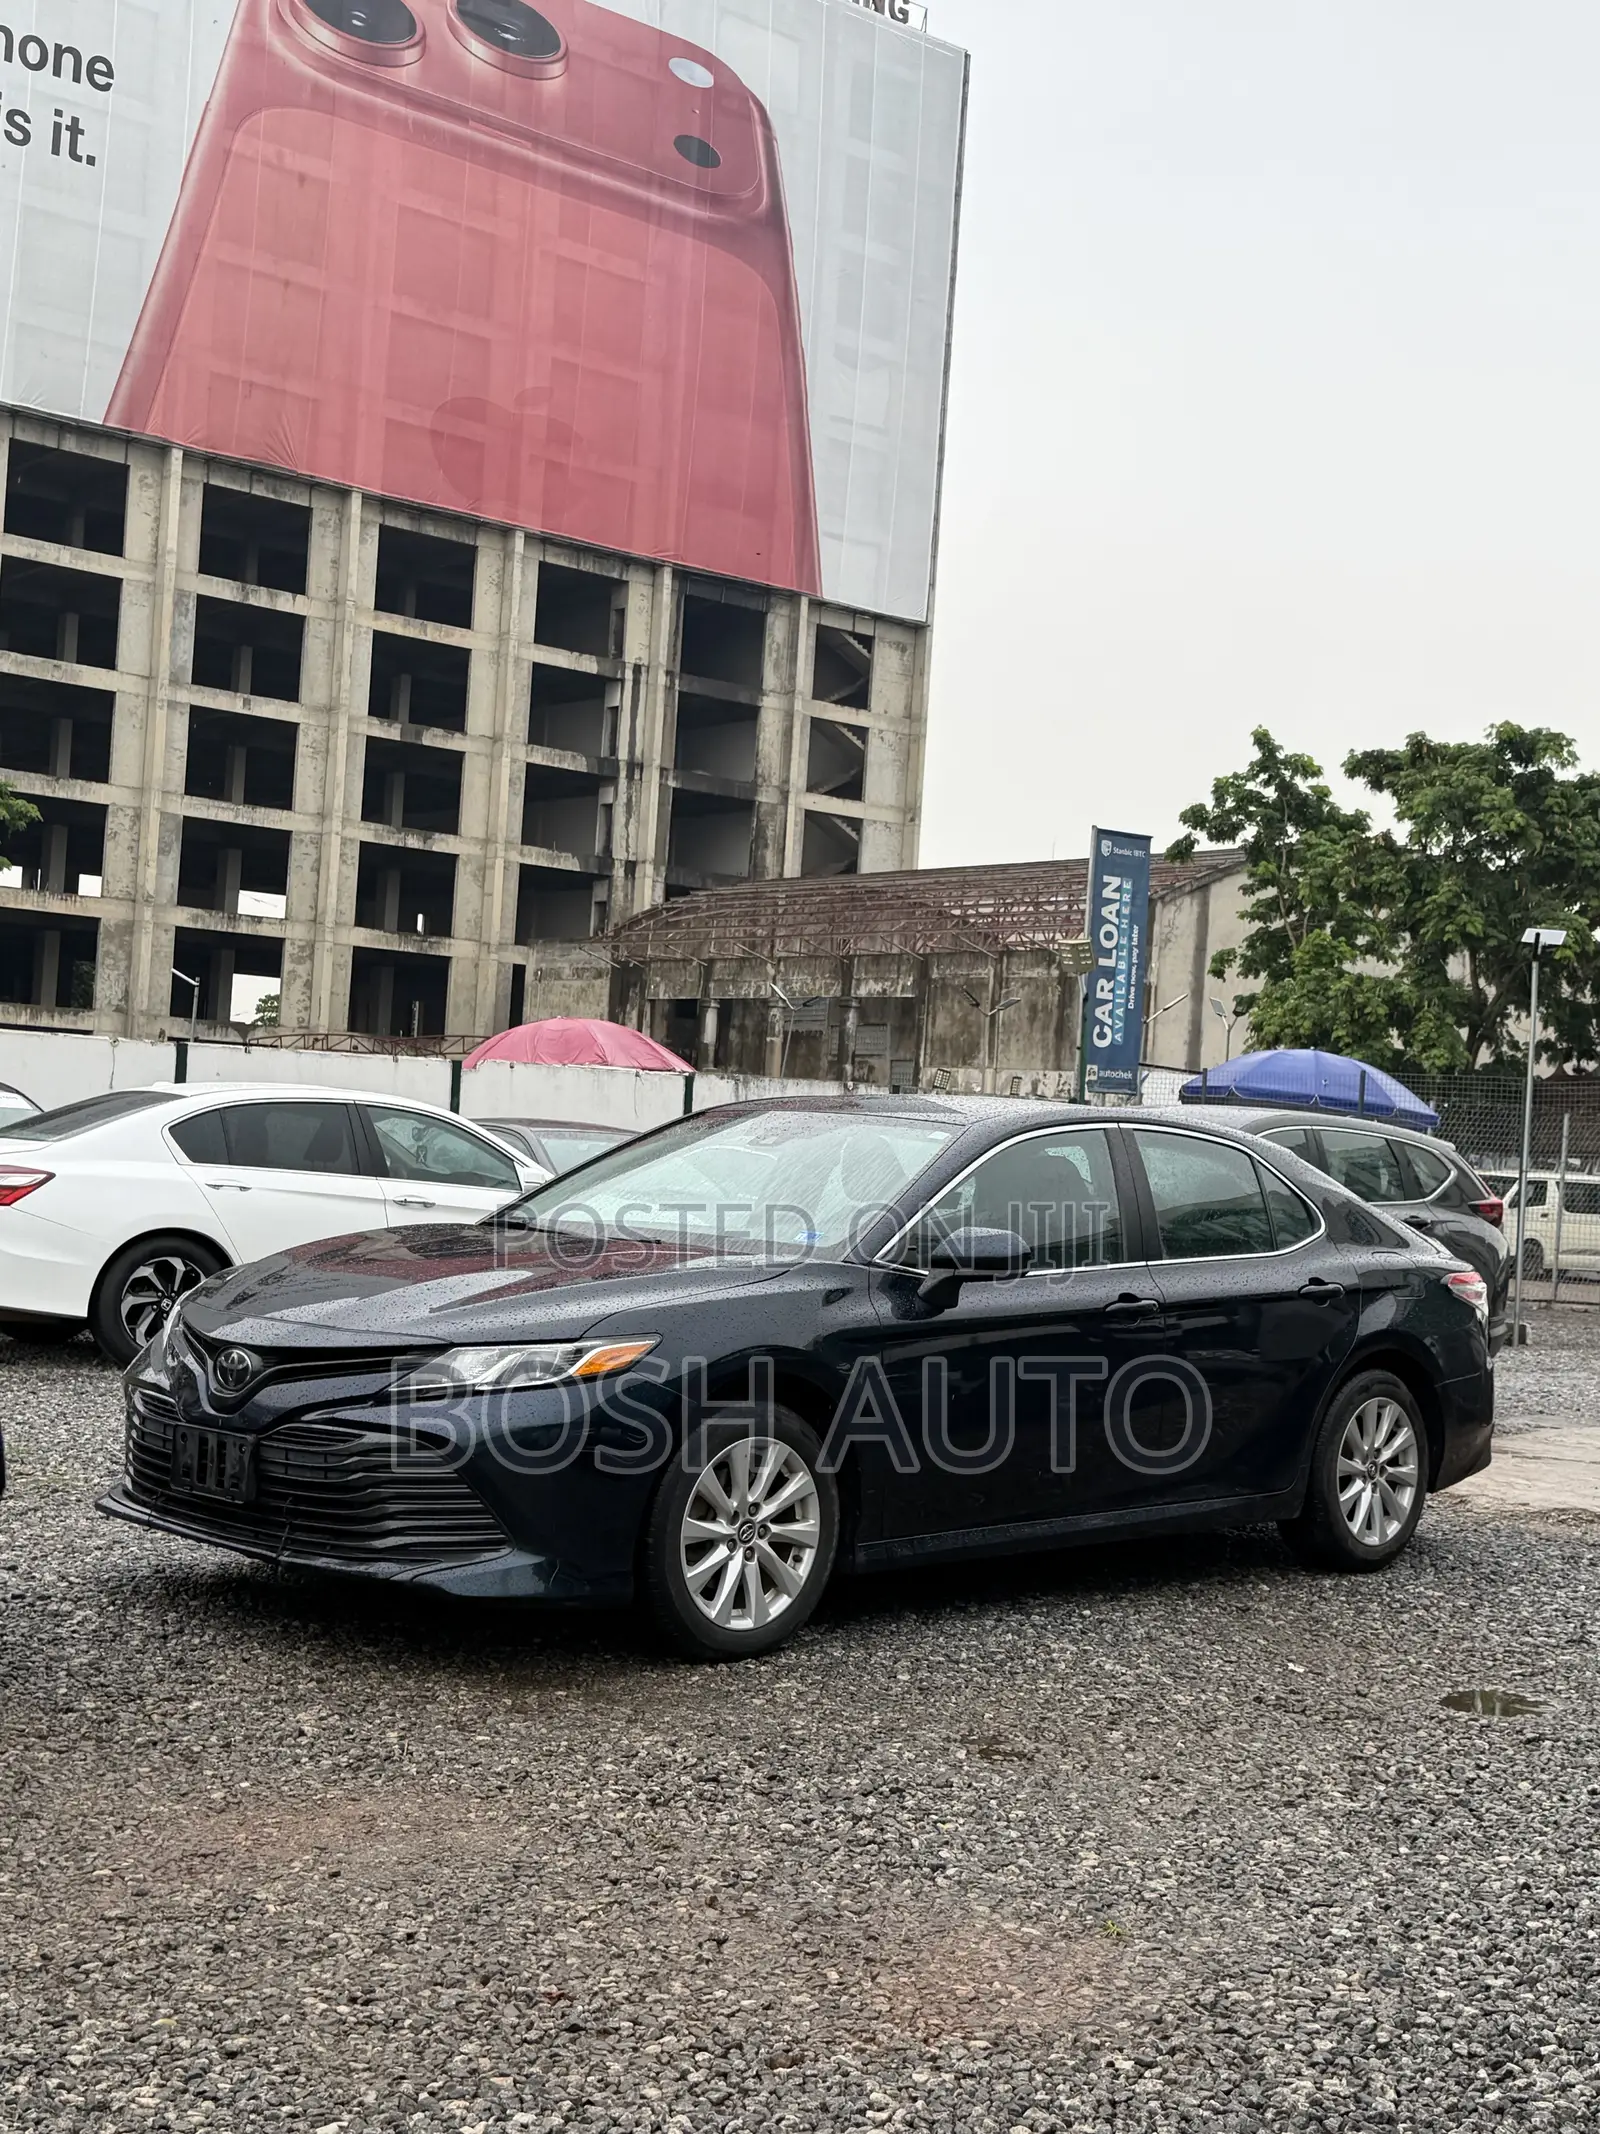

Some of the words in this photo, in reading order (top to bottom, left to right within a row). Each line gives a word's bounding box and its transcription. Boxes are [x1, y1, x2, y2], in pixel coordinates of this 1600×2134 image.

[0, 91, 31, 147] s
[51, 108, 96, 167] it.
[1098, 874, 1122, 967] LOAN
[1131, 924, 1139, 946] later
[1114, 935, 1128, 1042] AVAILABLE
[1121, 880, 1132, 928] HERE
[1092, 978, 1115, 1048] CAR
[1128, 986, 1136, 1009] Drive
[1099, 1069, 1132, 1079] autochek
